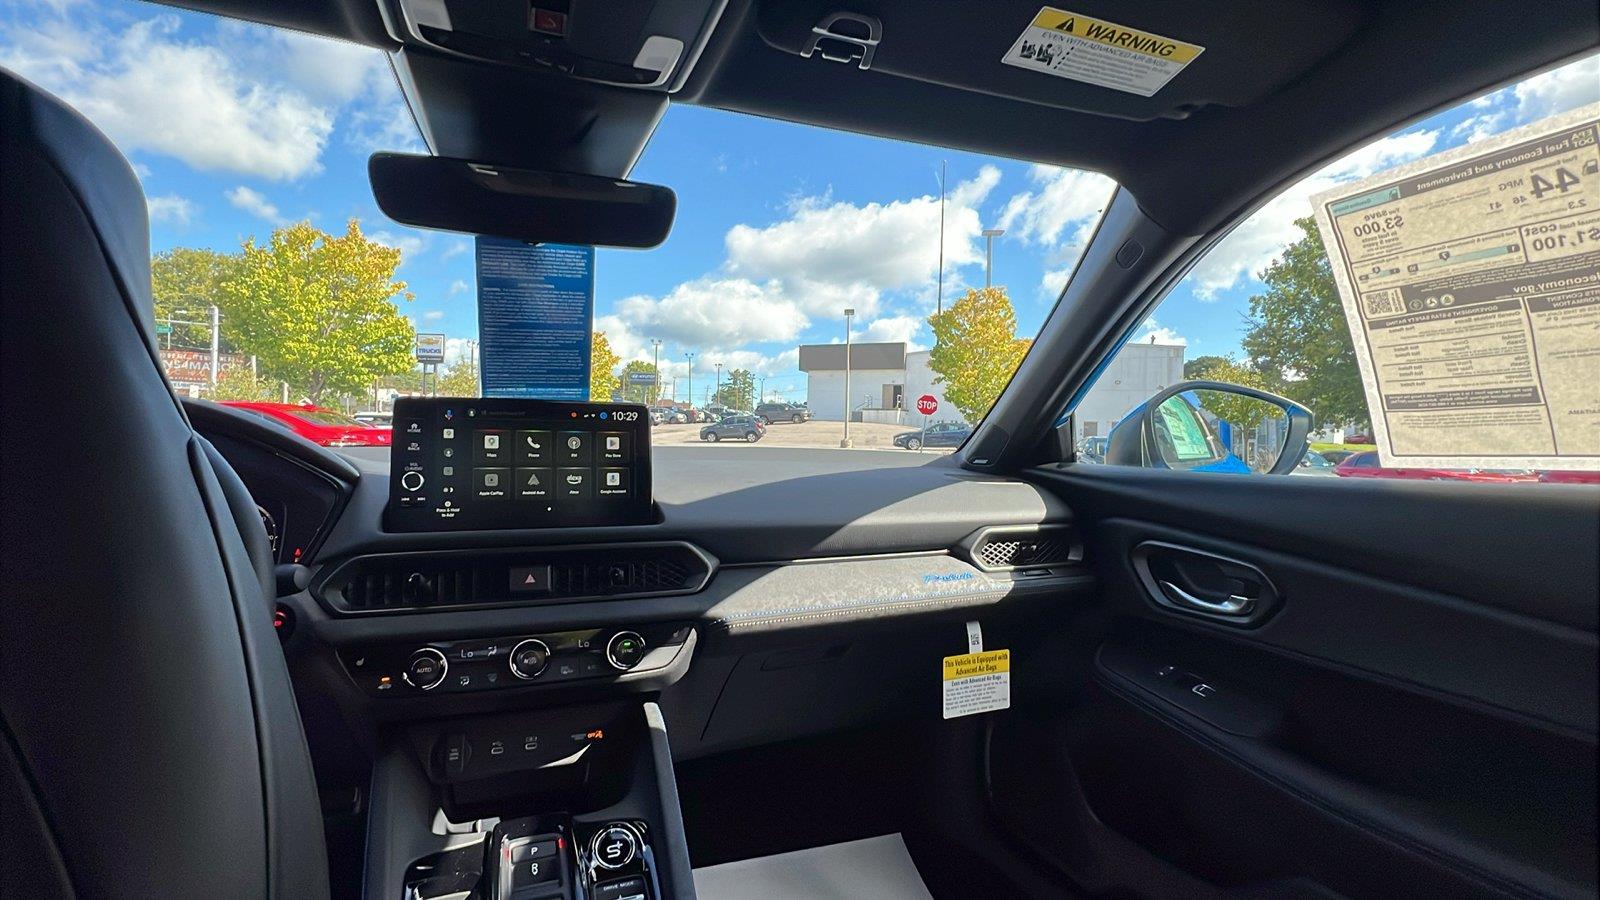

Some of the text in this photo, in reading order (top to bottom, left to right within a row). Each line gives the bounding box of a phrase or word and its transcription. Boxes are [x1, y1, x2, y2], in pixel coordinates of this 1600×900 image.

[1041, 31, 1064, 42] EVEN
[1086, 23, 1176, 56] WARNING
[918, 400, 937, 410] STOP
[611, 411, 638, 421] 10:29
[955, 658, 971, 666] Vehicle
[977, 654, 997, 664] Equipped
[956, 667, 977, 676] Advanced
[986, 664, 997, 672] Bags
[531, 846, 538, 856] P
[603, 881, 634, 891] DRIVE MODE
